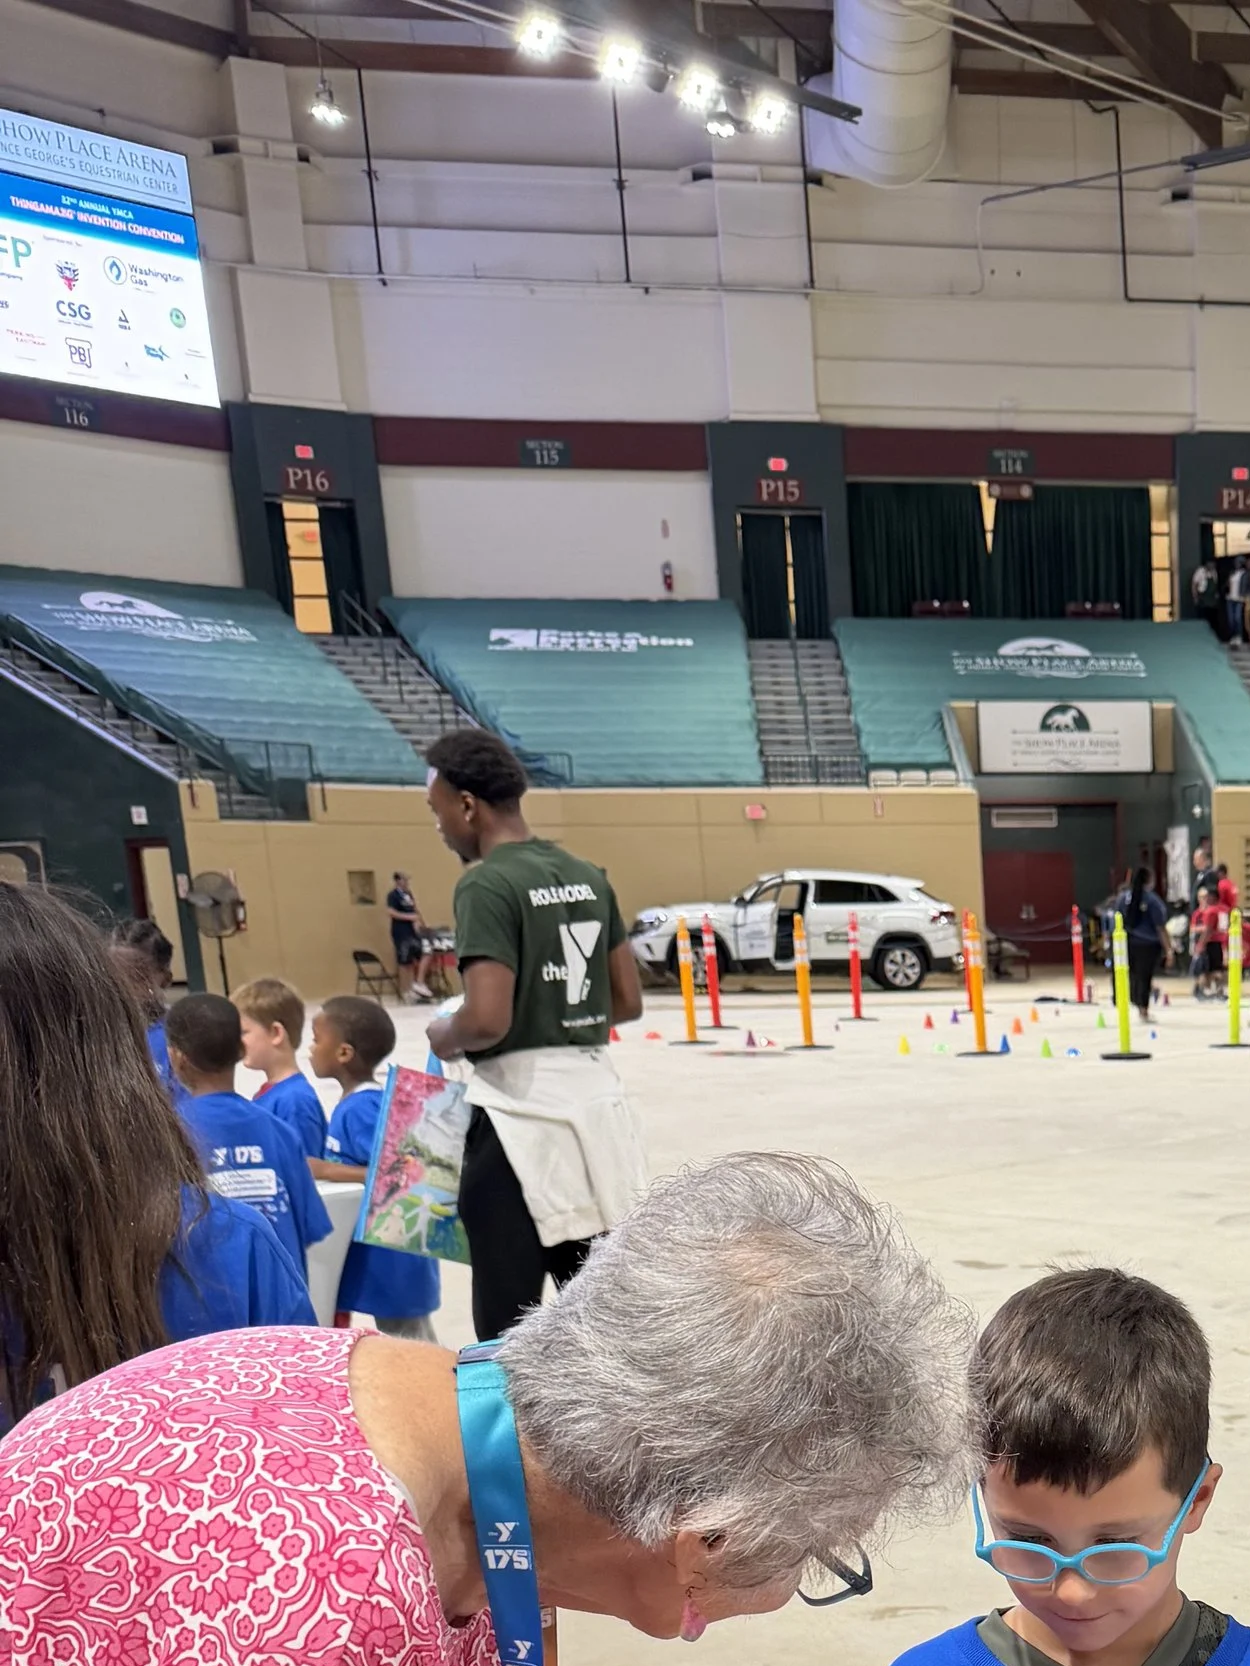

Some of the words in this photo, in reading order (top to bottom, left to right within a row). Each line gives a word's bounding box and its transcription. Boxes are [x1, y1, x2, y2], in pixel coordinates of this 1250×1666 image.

[55, 131, 113, 163] PLACE
[117, 150, 177, 178] ARENA
[24, 148, 75, 168] GEORGE'S
[80, 161, 140, 184] EQUESTRIAN
[143, 177, 178, 193] CENTER
[77, 212, 127, 232] INVENTION
[128, 221, 185, 244] CONVENTION
[128, 263, 184, 283] Washington
[130, 277, 148, 287] Gas
[56, 300, 91, 321] CSG
[65, 408, 89, 426] 116
[535, 450, 560, 465] 115
[287, 468, 330, 492] P16
[760, 479, 799, 501] P15
[542, 961, 568, 981] the
[484, 1549, 529, 1570] 175
